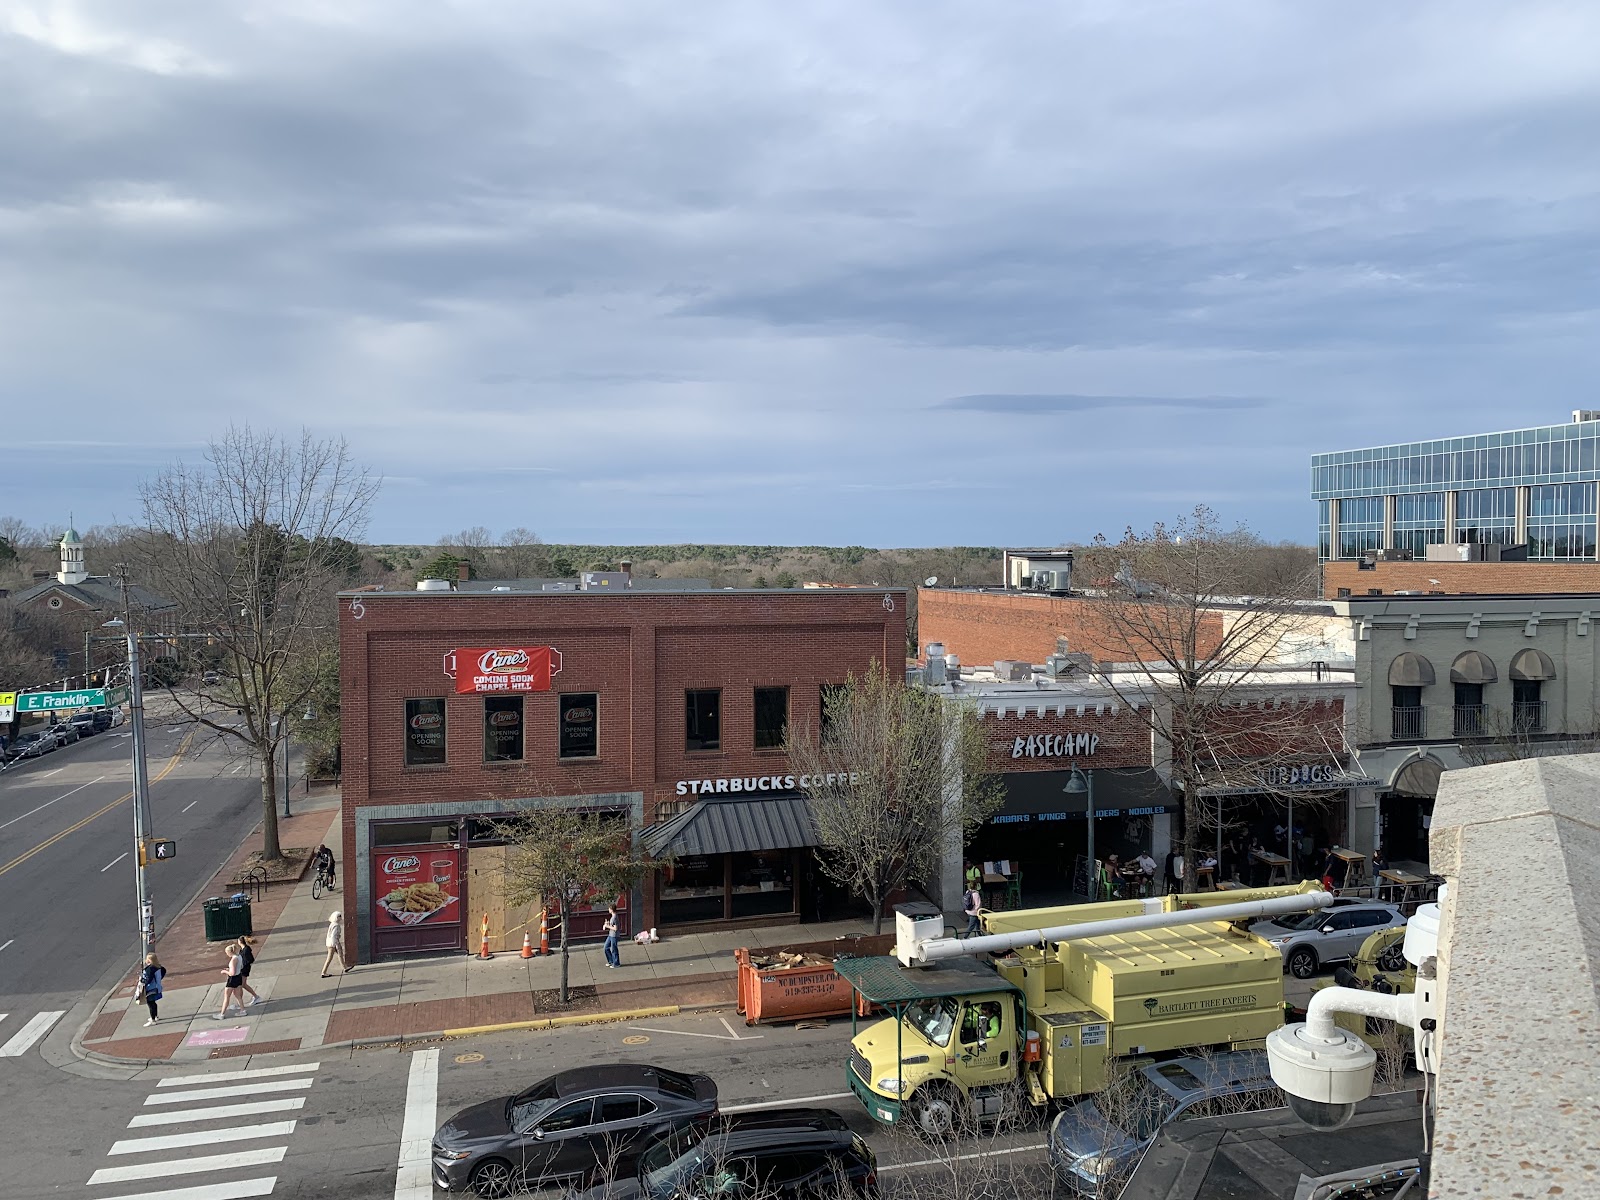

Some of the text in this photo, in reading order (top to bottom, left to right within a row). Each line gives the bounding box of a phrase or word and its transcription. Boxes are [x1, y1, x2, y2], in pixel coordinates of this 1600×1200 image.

[480, 650, 528, 674] Cane's
[473, 674, 534, 684] COMING SOON
[475, 682, 532, 691] CHAPEL HILL
[28, 694, 90, 709] E. Franklin
[411, 713, 441, 728] Cane's
[491, 711, 520, 726] Cane's
[565, 708, 593, 722] Cane's
[1011, 732, 1100, 759] BASECAMP
[675, 775, 796, 796] STARBUCKS
[1038, 812, 1067, 821] WINGS
[1128, 806, 1165, 815] NOODLES
[383, 856, 420, 874] Cane's
[778, 979, 788, 988] NC
[1158, 1001, 1199, 1013] BARTLETT
[1200, 999, 1221, 1008] TREE
[1222, 994, 1257, 1006] EXPERTS
